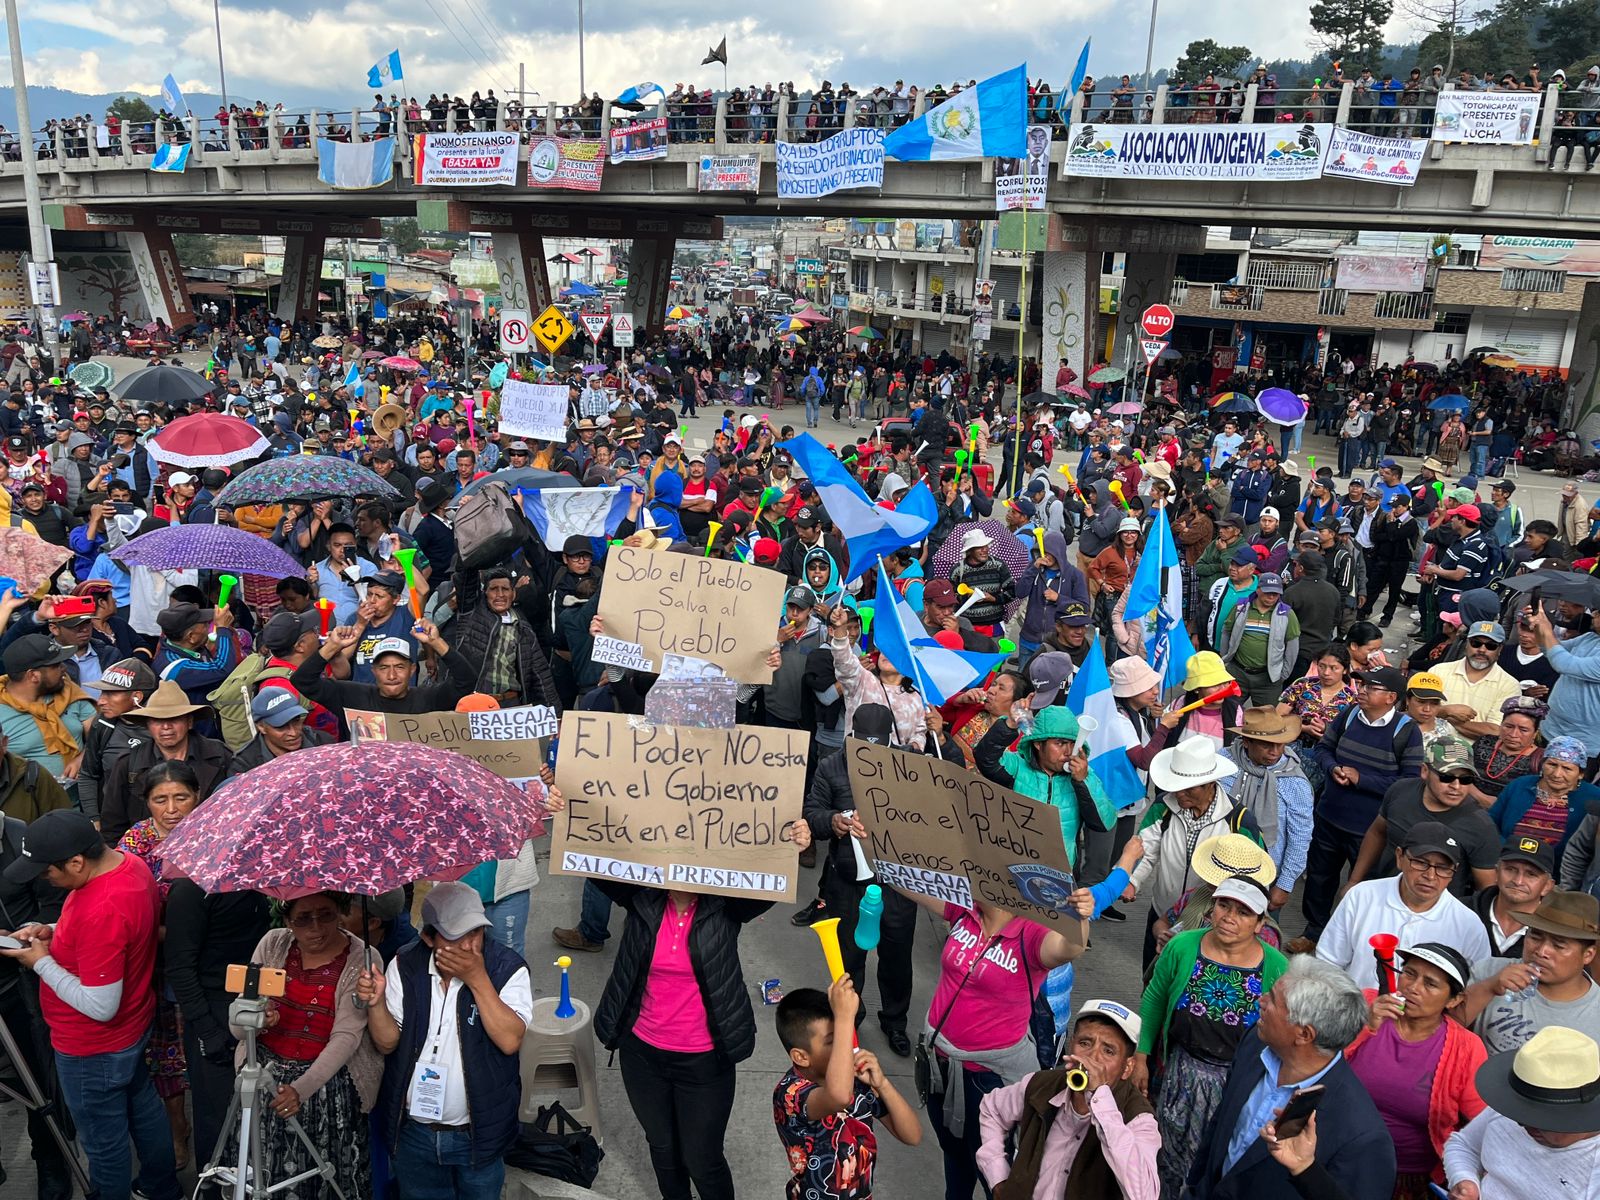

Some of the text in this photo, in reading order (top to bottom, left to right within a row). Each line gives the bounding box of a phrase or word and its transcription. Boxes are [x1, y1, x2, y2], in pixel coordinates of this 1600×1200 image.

[653, 118, 665, 127] YA!
[1462, 111, 1516, 120] PRESENTES
[434, 136, 513, 147] MOMOSTENANGO
[787, 145, 797, 159] A
[819, 128, 885, 154] CORRUPTOS
[1347, 133, 1360, 141] SAN
[1362, 135, 1383, 146] MATEO
[1463, 129, 1502, 139] LUCHA
[437, 149, 467, 157] presente
[479, 147, 485, 155] la
[486, 147, 505, 155] lucha
[1118, 131, 1266, 164] ASOCIACION INDIGENA
[1332, 140, 1422, 160] ESTA CON LOS 48 CANTONES
[445, 157, 496, 168] ¡BASTA YA!
[563, 161, 595, 170] PRESENTE
[793, 157, 830, 175] ESTADO
[1123, 164, 1144, 175] SAN
[1147, 165, 1208, 177] FRANCISCO
[1210, 165, 1224, 177] EL
[1230, 165, 1255, 177] ALTO
[566, 170, 575, 178] LA
[576, 172, 598, 180] LUCHA
[717, 173, 748, 182] PRESENTE
[997, 187, 1031, 196] RENUNCIN
[800, 260, 824, 272] Hola
[1145, 315, 1170, 326] ALTO
[1144, 342, 1161, 350] CEDA
[502, 394, 511, 406] EL
[515, 397, 544, 412] PUEBLO
[517, 411, 549, 425] QUIERE
[616, 549, 752, 592] Solo el Pueblo
[659, 586, 738, 617] Salva al
[633, 608, 737, 655] Pueblo
[592, 649, 651, 670] PRESENTE
[400, 718, 473, 744] Pueblo
[471, 721, 557, 740] PRESENTE
[575, 717, 807, 767] El Poder NO esta
[583, 767, 779, 806] en el Gobierno
[856, 746, 1044, 836] Si No hay PAZ
[566, 799, 796, 850] Está en el Pueblo
[865, 787, 1041, 860] Para el Pueblo
[871, 829, 954, 872] Menos
[959, 859, 1004, 883] para
[565, 854, 786, 892] SALCAJÁ PRESENTE
[878, 872, 973, 909] PRESENTE
[978, 880, 1059, 920] Gobierno
[945, 946, 988, 979] 197
